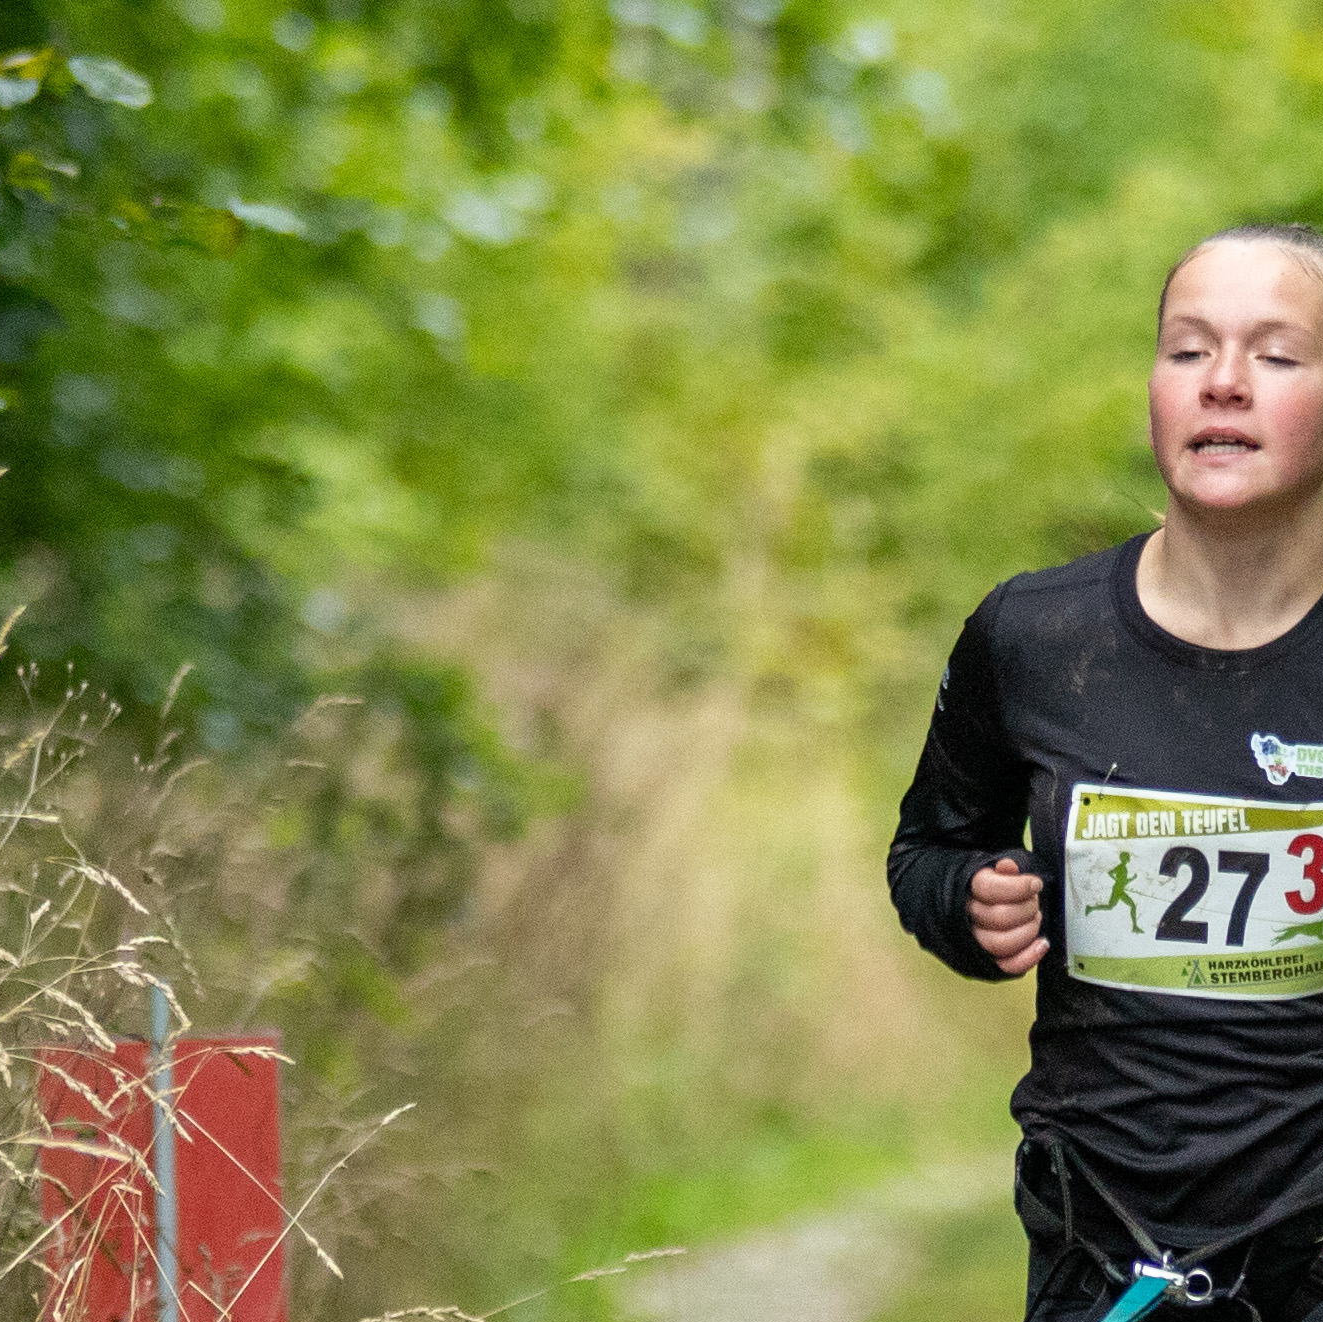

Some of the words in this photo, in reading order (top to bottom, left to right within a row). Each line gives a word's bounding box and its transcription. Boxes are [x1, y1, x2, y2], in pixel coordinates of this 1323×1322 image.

[1082, 812, 1131, 840] JAGT
[1135, 810, 1176, 836] DEN
[1182, 807, 1251, 835] TEUFEL
[1155, 846, 1270, 947] 27
[1208, 954, 1304, 971] HARZKÖHLEREI
